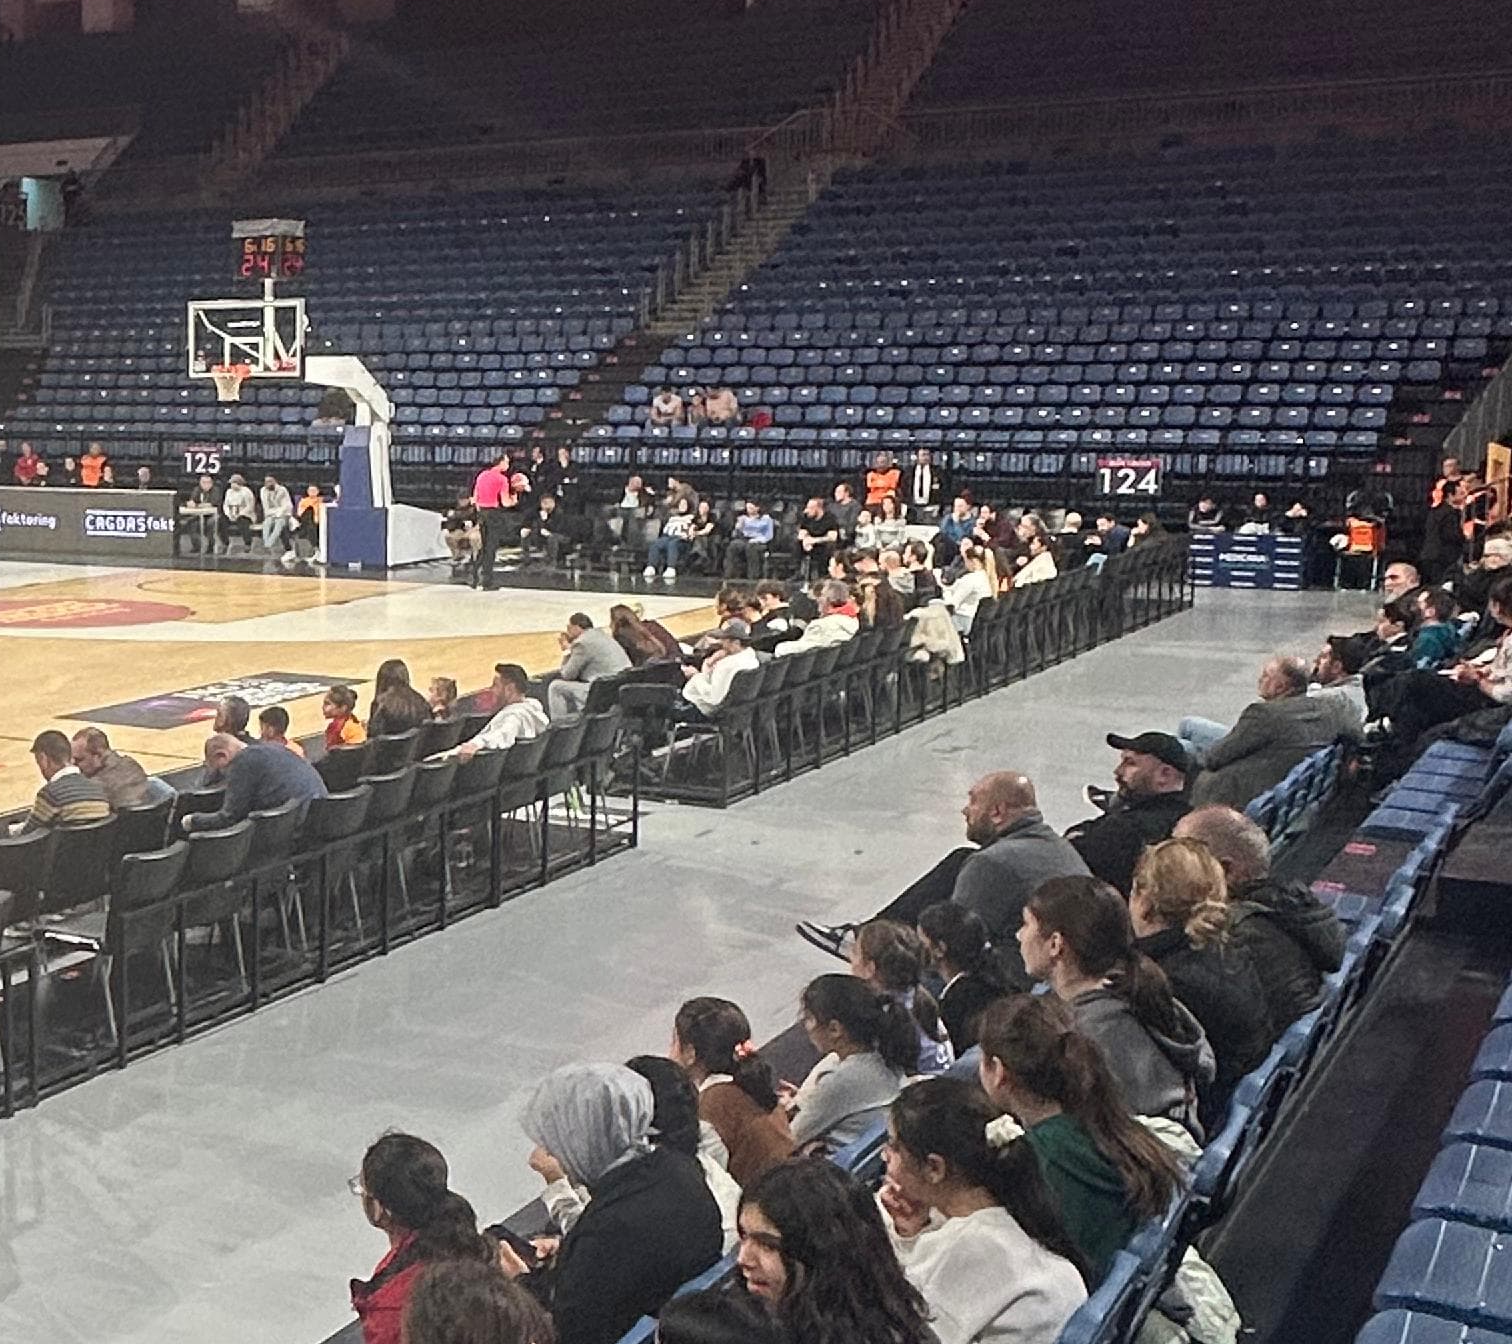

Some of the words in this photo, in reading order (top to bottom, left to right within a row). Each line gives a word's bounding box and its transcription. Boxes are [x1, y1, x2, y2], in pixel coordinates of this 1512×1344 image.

[242, 255, 270, 276] 24
[184, 452, 221, 473] 125
[1099, 467, 1159, 494] 124
[85, 515, 147, 532] CAGDAS
